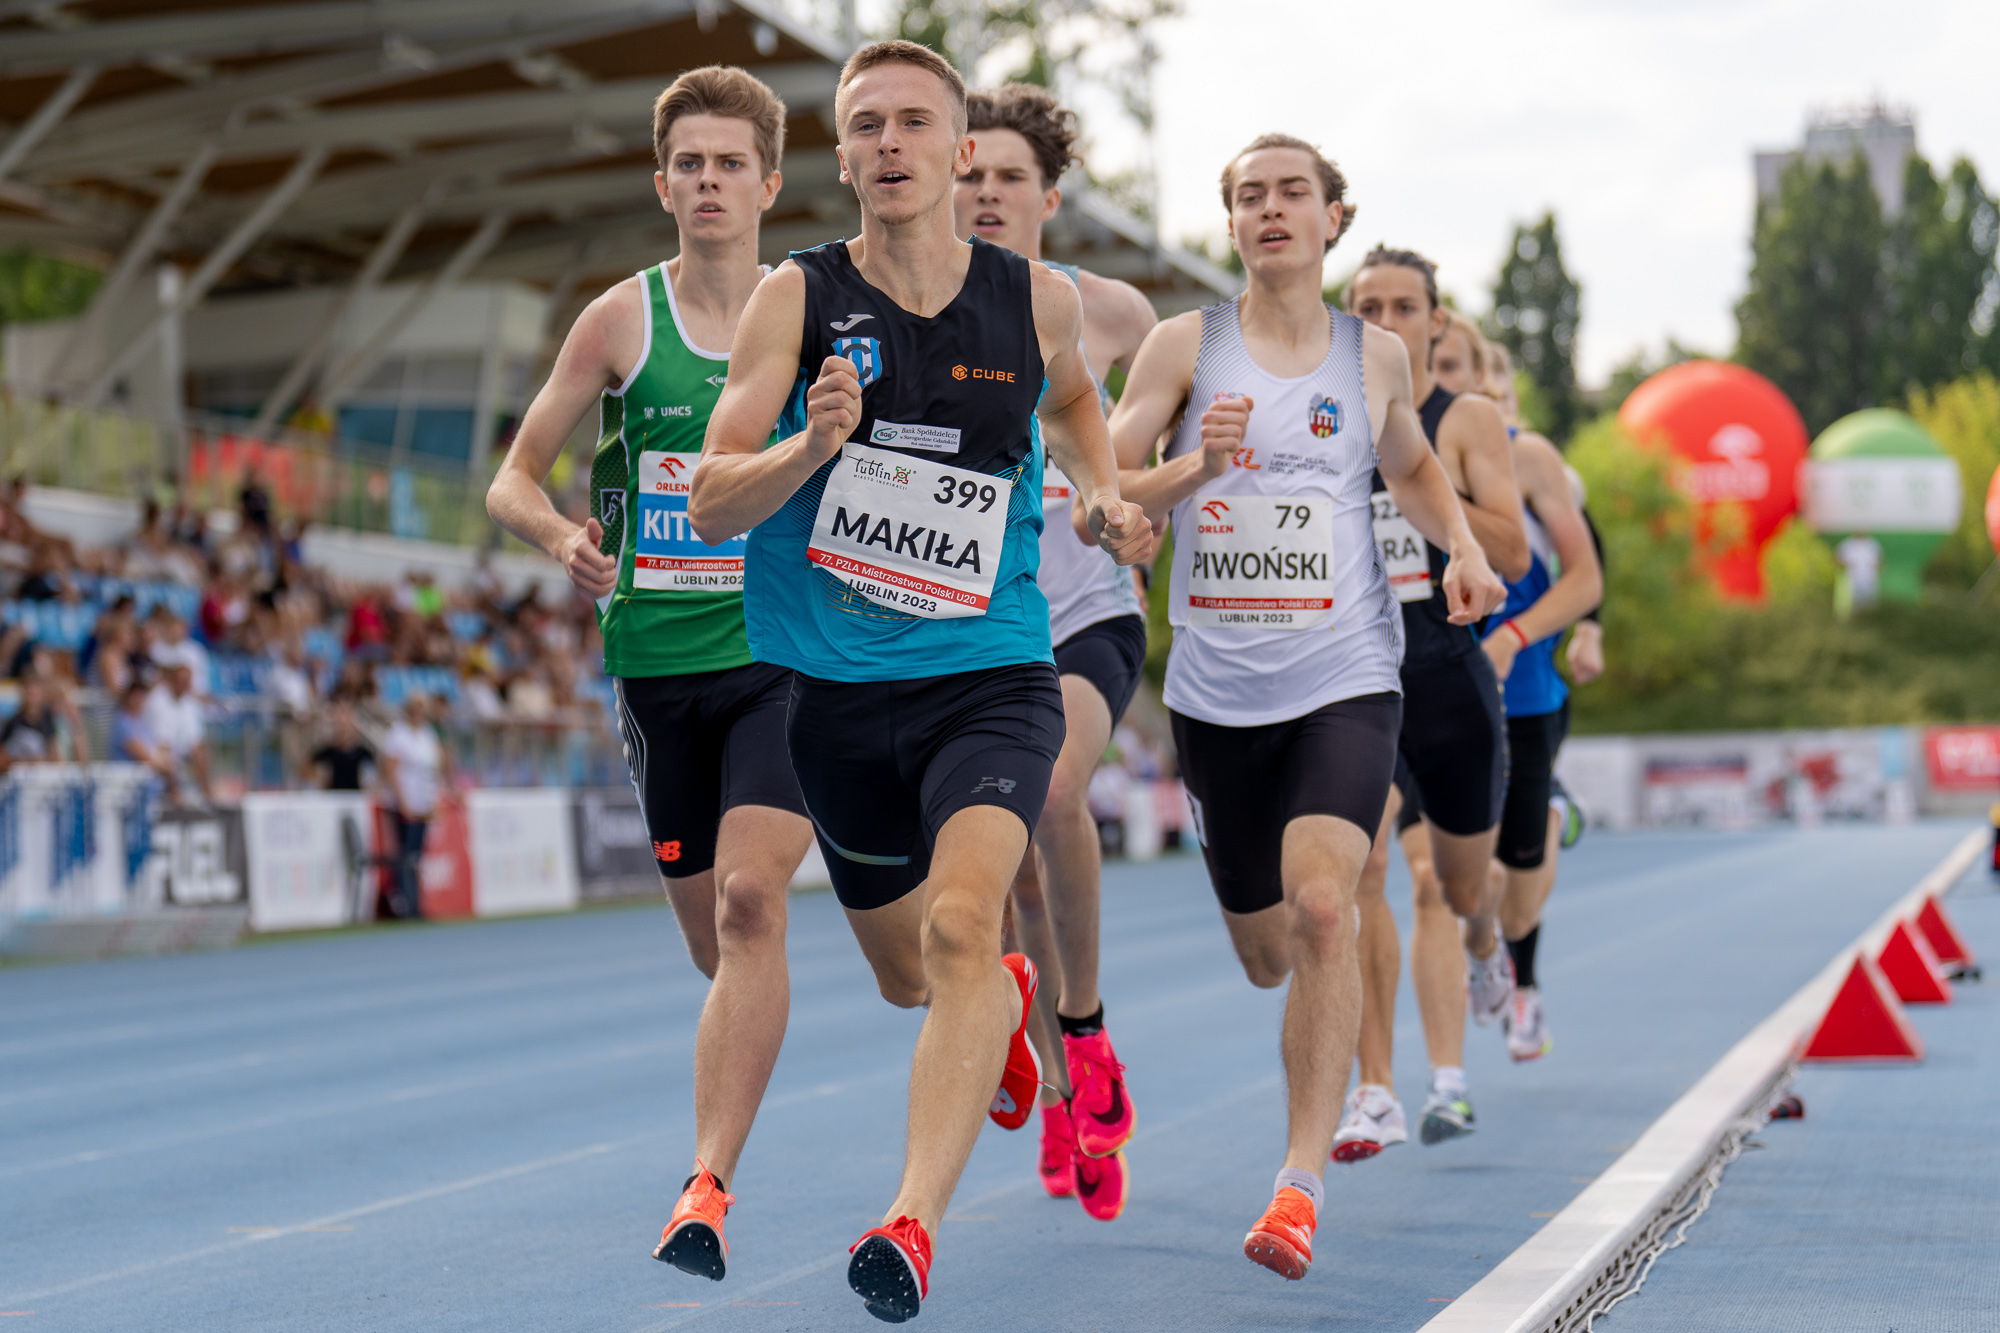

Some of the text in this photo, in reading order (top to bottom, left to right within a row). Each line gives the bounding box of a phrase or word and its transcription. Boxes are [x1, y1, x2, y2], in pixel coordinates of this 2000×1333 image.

[973, 368, 1016, 383] CUBE
[660, 405, 693, 417] UMCS
[916, 428, 959, 440] Spółdzielczy
[853, 474, 874, 482] MIASTO
[656, 481, 690, 492] ORLEN
[933, 474, 997, 514] 399
[1275, 504, 1311, 530] 79
[1198, 525, 1234, 534] ORLEN
[830, 505, 982, 575] MAKIŁA
[646, 558, 658, 568] 77.
[659, 560, 680, 569] PZLA
[681, 561, 736, 570] Mistrzostwa
[1193, 546, 1327, 580] PIWOŃSKI
[673, 574, 718, 586] LUBLIN
[819, 553, 977, 606] 77. PZLA Mistrzostwa Polski U20
[849, 578, 899, 602] LUBLIN
[901, 593, 937, 612] 2023
[1205, 599, 1224, 608] PZLA
[1225, 600, 1277, 609] Mistrzostwa
[1279, 600, 1304, 609] Polski
[1306, 601, 1324, 609] U20
[1219, 613, 1293, 623] LUBLIN 2023
